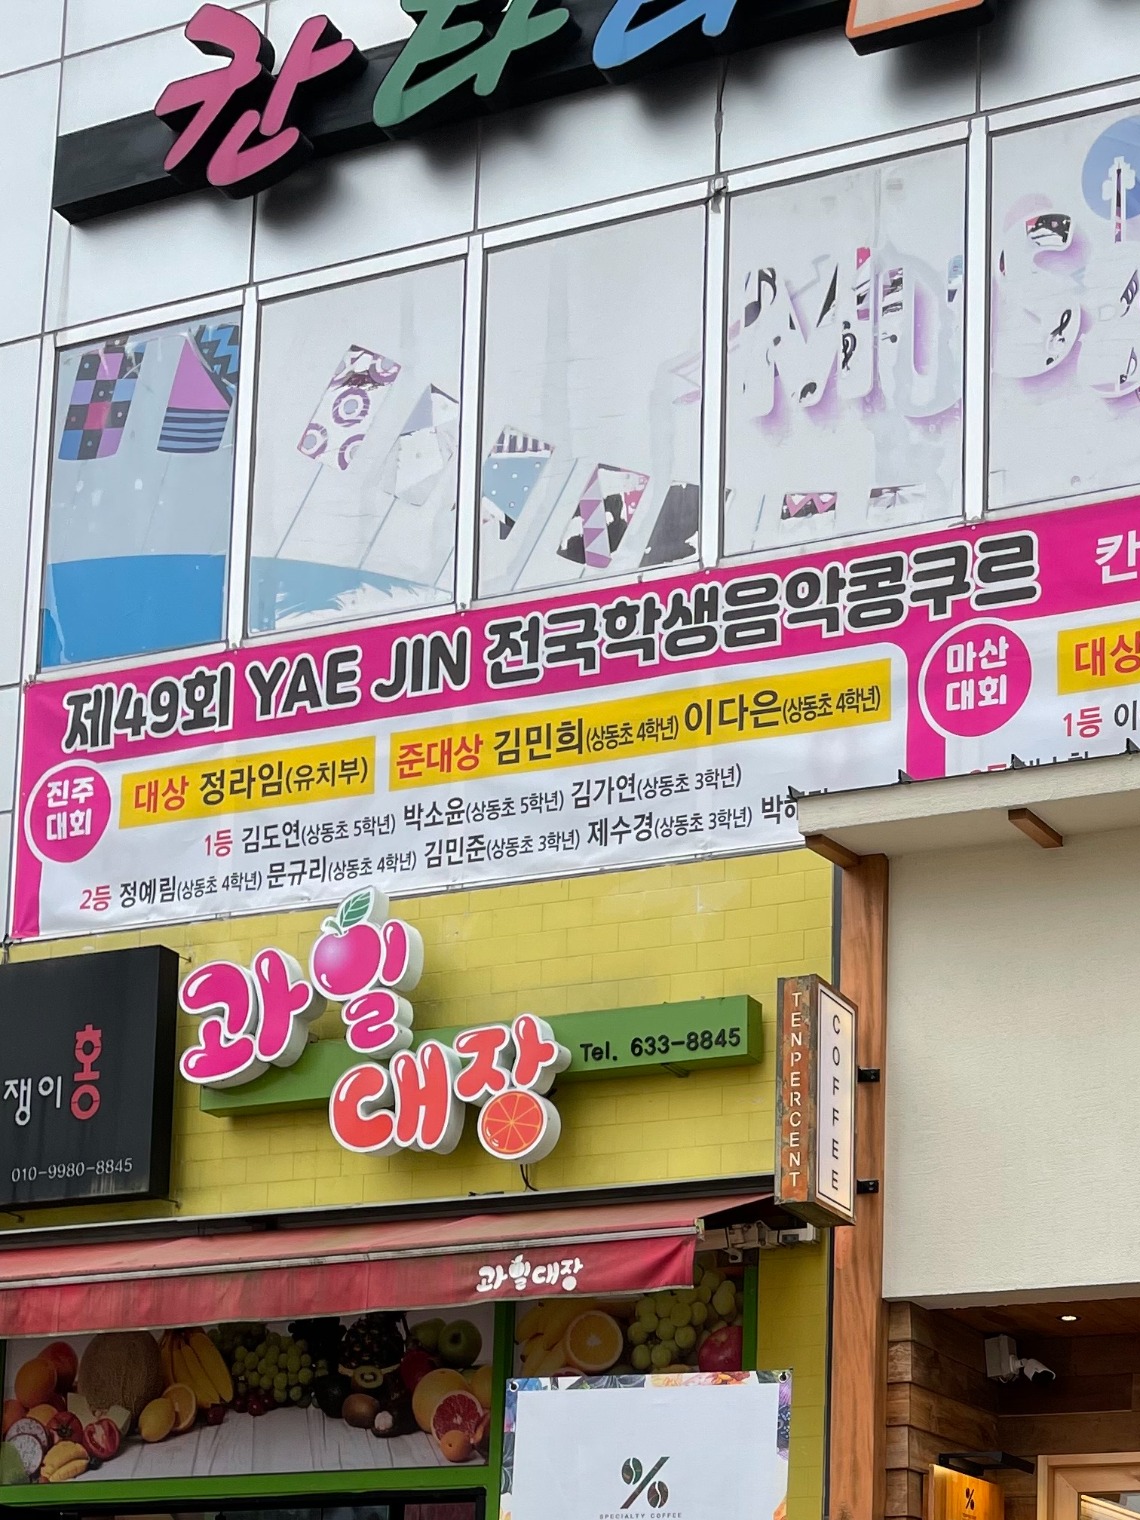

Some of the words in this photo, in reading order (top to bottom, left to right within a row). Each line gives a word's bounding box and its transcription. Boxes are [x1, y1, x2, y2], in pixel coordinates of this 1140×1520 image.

[65, 666, 232, 750] 제49회
[250, 648, 360, 718] YAE
[375, 631, 468, 699] JIN
[486, 534, 1038, 686] 전국학생음악콩쿠르
[946, 635, 1010, 675] 마산
[946, 675, 1009, 712] 대회
[1062, 706, 1103, 738] 1등
[46, 777, 95, 808] 진주
[134, 778, 190, 815] 대상
[199, 755, 369, 806] 정라임(유치부)
[396, 733, 484, 780] 준대상
[636, 713, 680, 742] 4학년)
[836, 684, 881, 717] 4학년)
[46, 811, 93, 842] 대회
[80, 884, 111, 912] 2등
[222, 868, 263, 894] 4학년)
[375, 848, 417, 876] 4학년)
[537, 828, 581, 855] 3학년)
[708, 805, 754, 834] 3학년)
[204, 829, 233, 861] 1등
[353, 812, 397, 840] 5학년)
[520, 789, 565, 816] 5학년)
[694, 762, 743, 793] 3학년)
[179, 906, 418, 1086] 과일
[71, 1024, 102, 1120] 홍
[328, 1013, 562, 1155] 대장
[580, 1040, 619, 1064] Tel.
[630, 1026, 743, 1058] 633-8845
[789, 992, 803, 1188] TENPERCENT
[831, 1014, 841, 1192] COFFEE
[11, 1157, 133, 1182] 010-9980-8845
